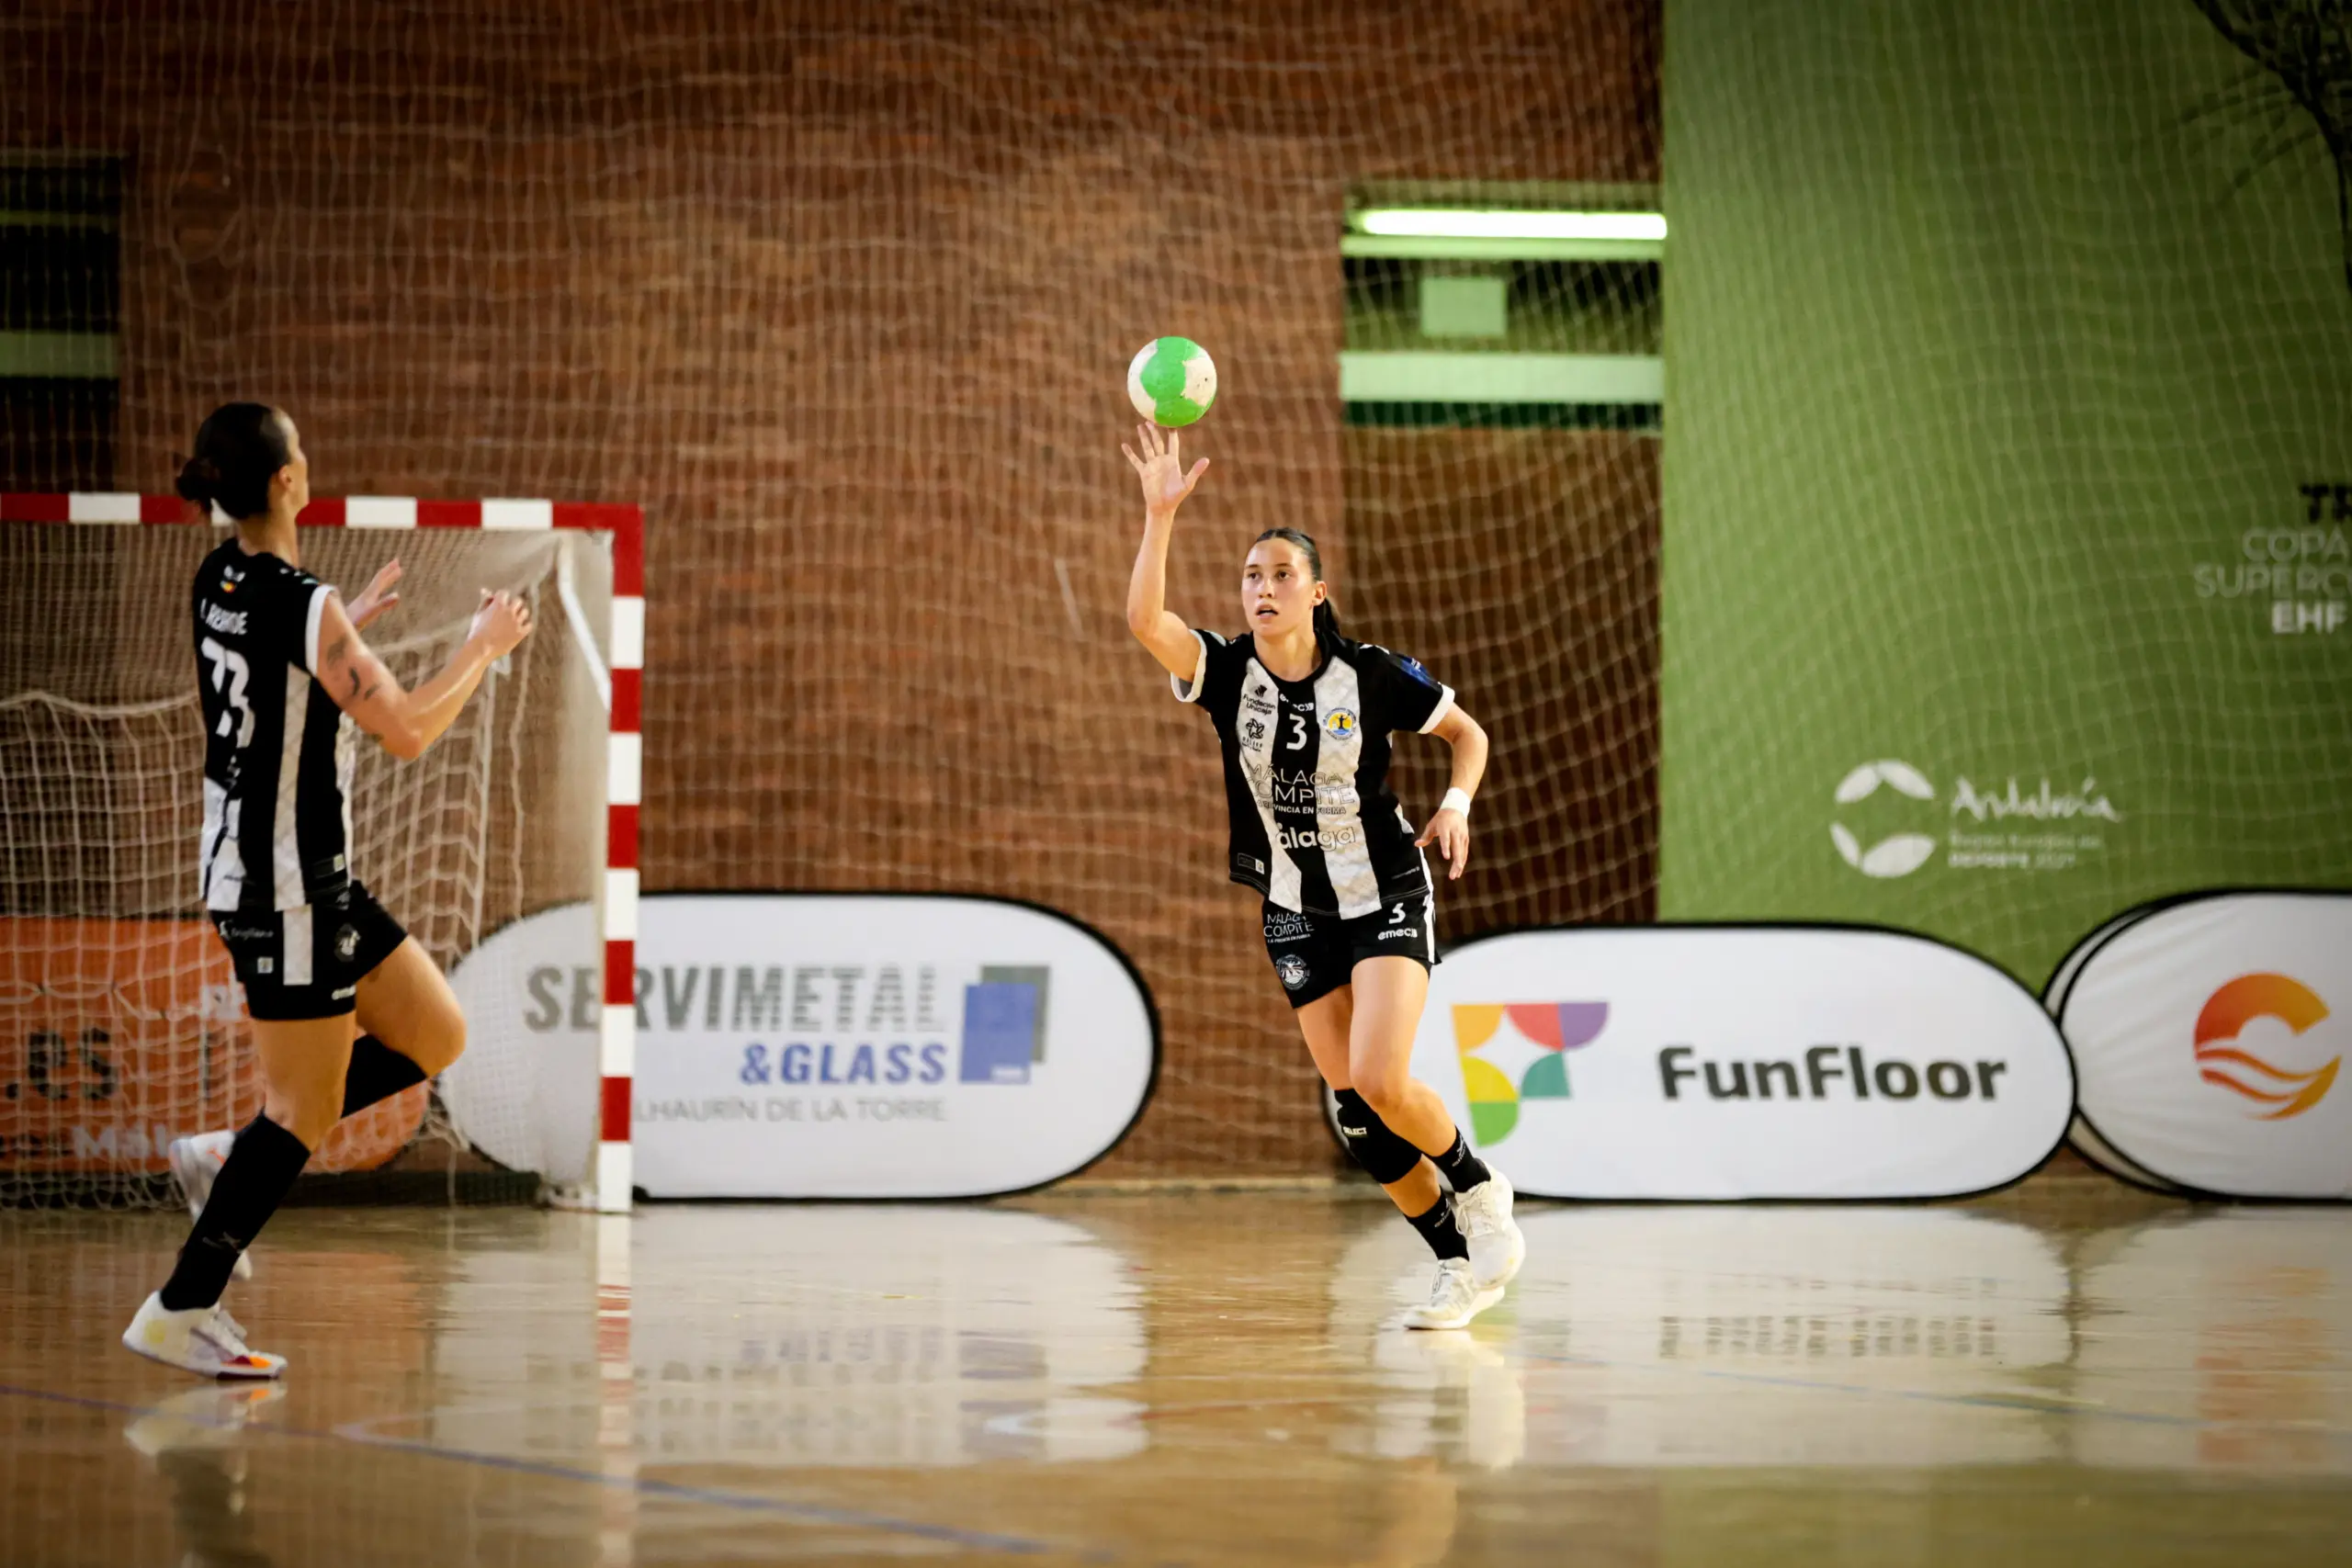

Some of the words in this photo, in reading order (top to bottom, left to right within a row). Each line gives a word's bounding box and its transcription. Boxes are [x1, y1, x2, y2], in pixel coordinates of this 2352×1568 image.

[2241, 526, 2351, 563] COPA
[2194, 563, 2352, 599] SUPERC
[2272, 601, 2348, 635] EHF
[1286, 713, 1307, 750] 3
[1302, 807, 1315, 815] EN
[1275, 822, 1356, 852] álaga
[522, 964, 950, 1033] SERVIMETAL
[739, 1043, 947, 1085] &GLASS
[1657, 1045, 2008, 1101] FunFloor
[765, 1097, 805, 1122] DE
[810, 1097, 847, 1122] LA
[855, 1096, 950, 1122] TORRE
